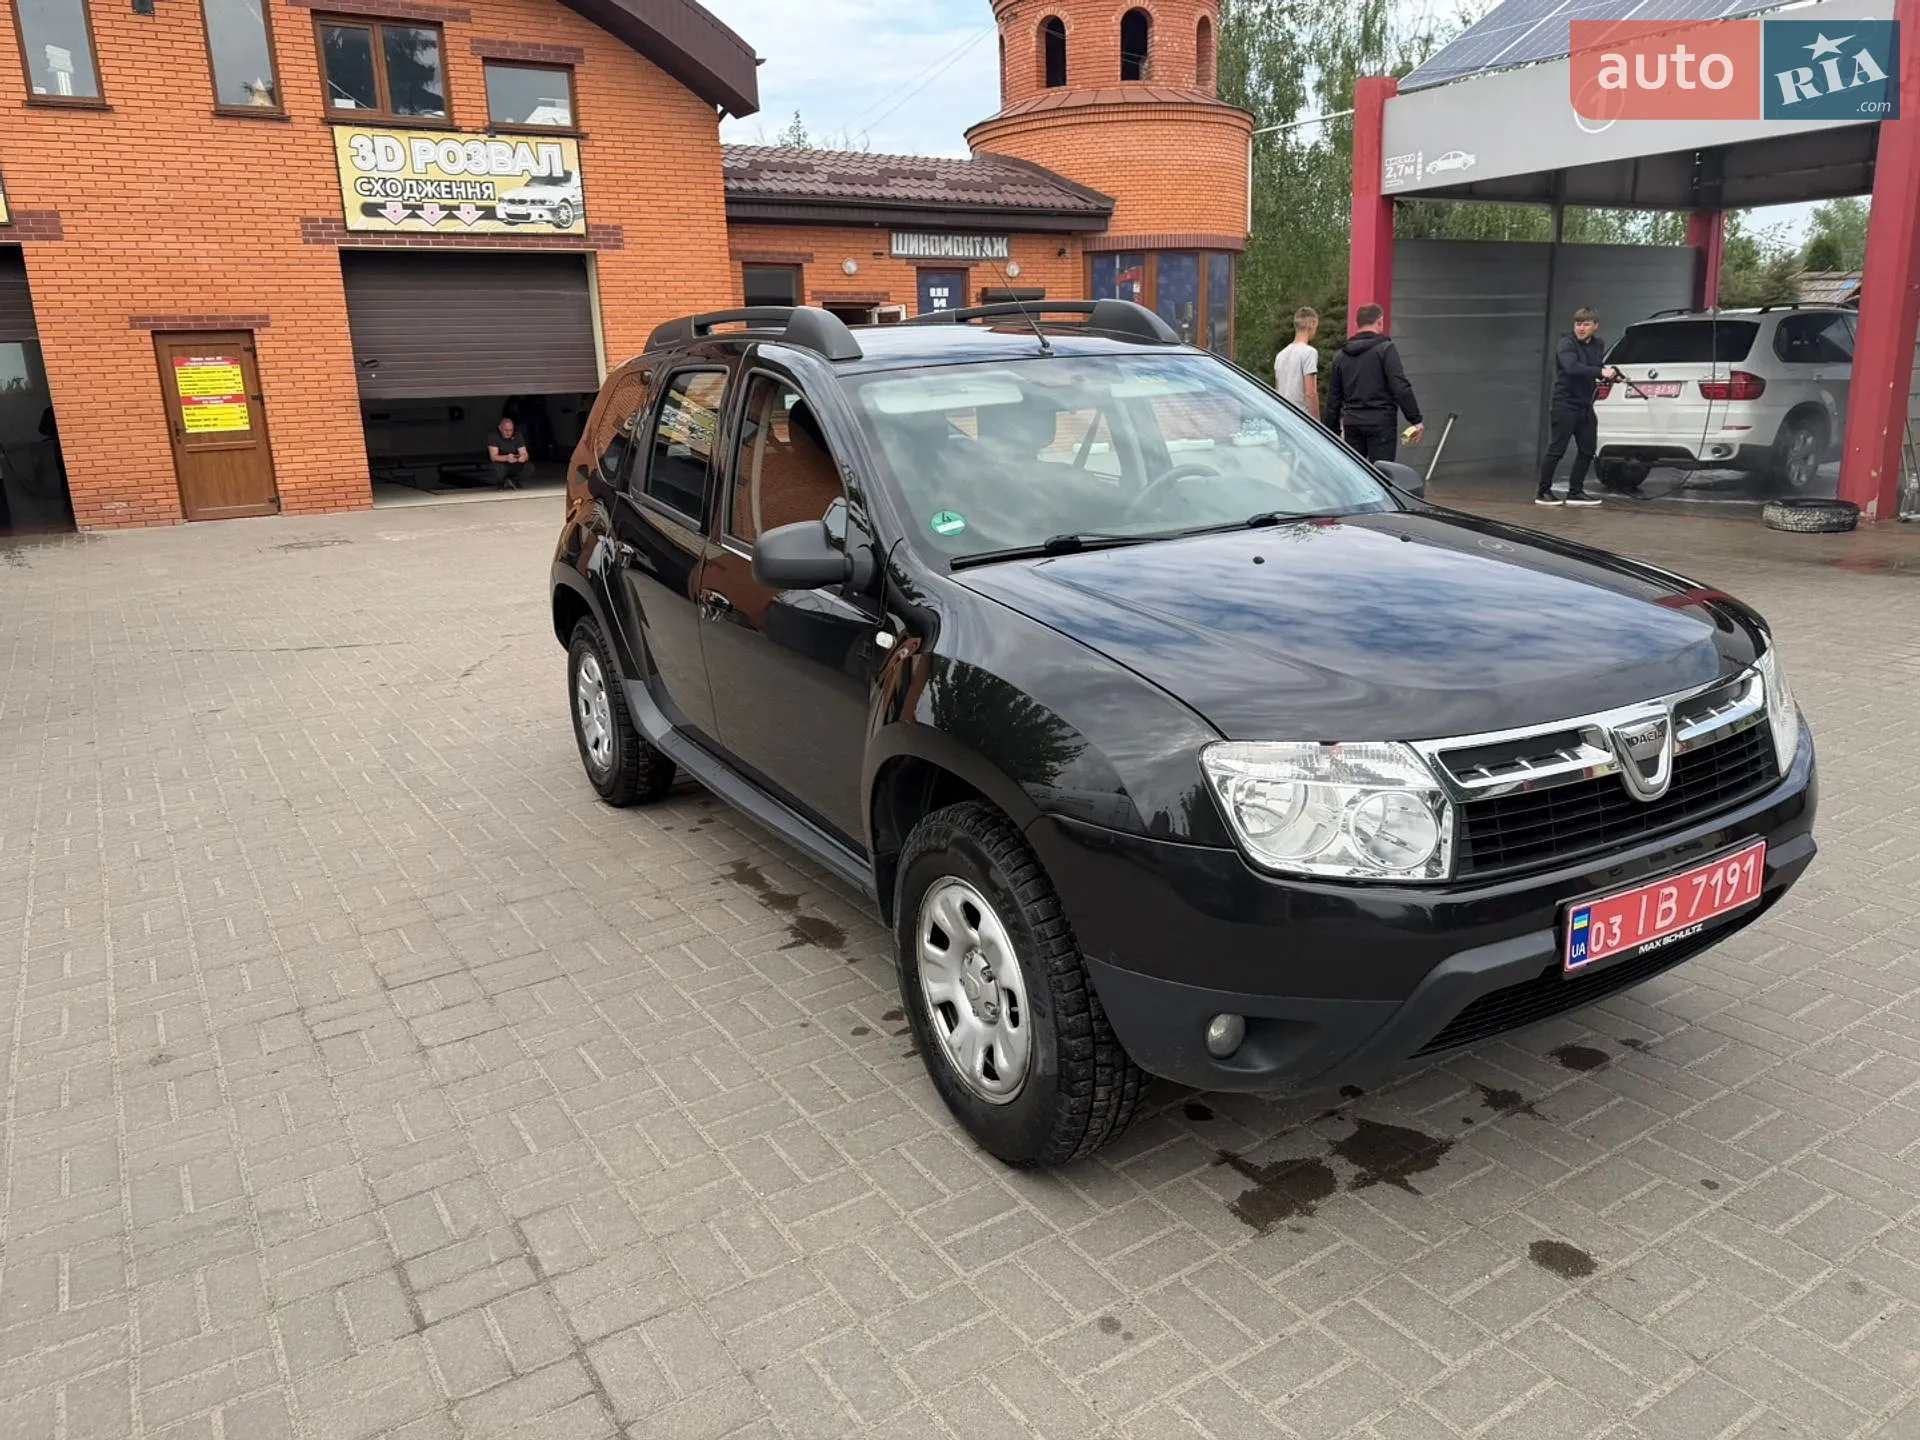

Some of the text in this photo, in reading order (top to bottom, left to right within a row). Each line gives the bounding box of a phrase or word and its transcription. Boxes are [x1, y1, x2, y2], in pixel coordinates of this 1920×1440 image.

[350, 134, 565, 177] 3D РОЗВАЛ
[354, 176, 496, 201] СХОДЖЕННЯ
[891, 233, 1009, 257] ШИНОМОНТАЖ
[929, 287, 949, 312] ШИ
[1590, 914, 1623, 953] 03
[1688, 854, 1756, 919] 7191
[1571, 944, 1586, 958] UA
[1638, 923, 1703, 955] MAX SCHULTZ
